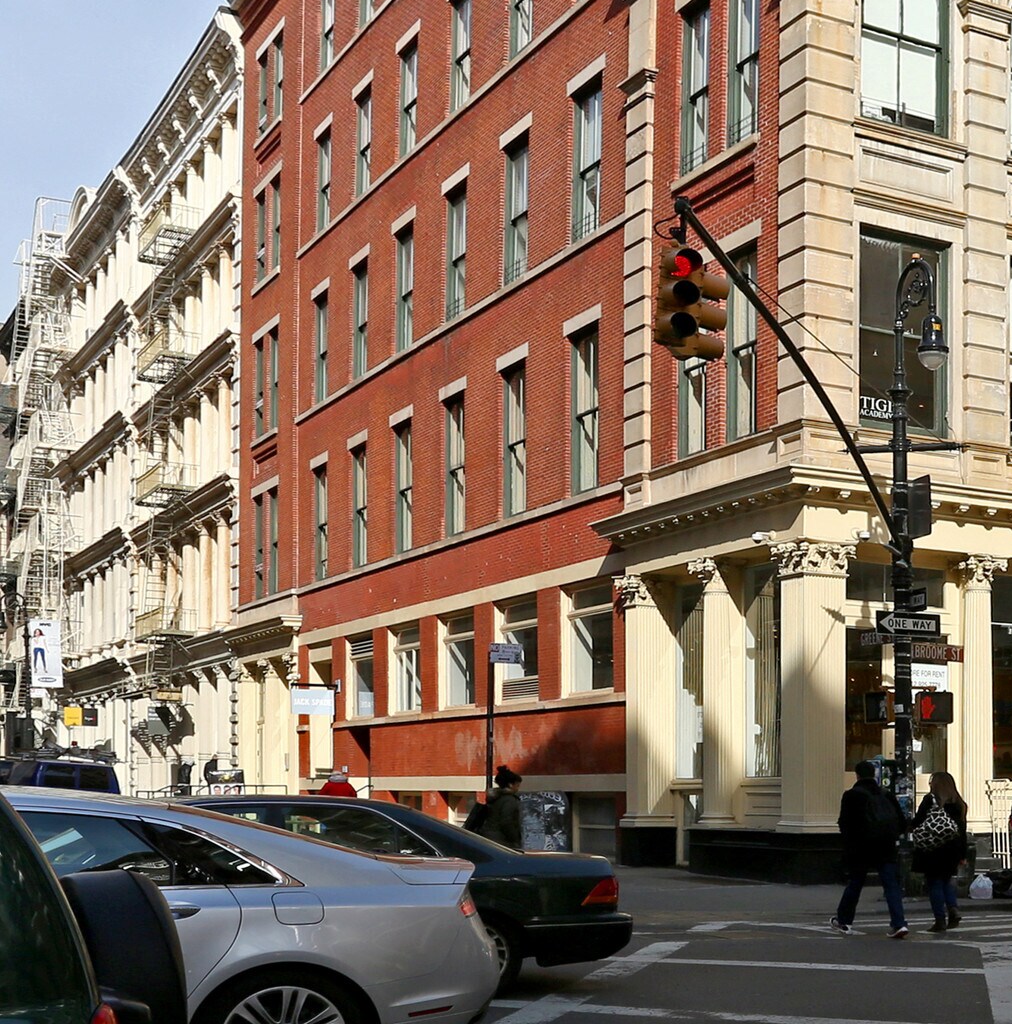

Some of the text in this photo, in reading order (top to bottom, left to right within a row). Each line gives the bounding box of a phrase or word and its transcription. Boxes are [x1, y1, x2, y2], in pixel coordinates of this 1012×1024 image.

[860, 396, 893, 413] TIGI
[860, 409, 894, 420] ACADEMY
[887, 618, 933, 631] ONE WAY
[914, 645, 961, 661] BROOME ST
[921, 670, 932, 678] FOR
[932, 670, 945, 679] RENT
[294, 697, 310, 707] JACK
